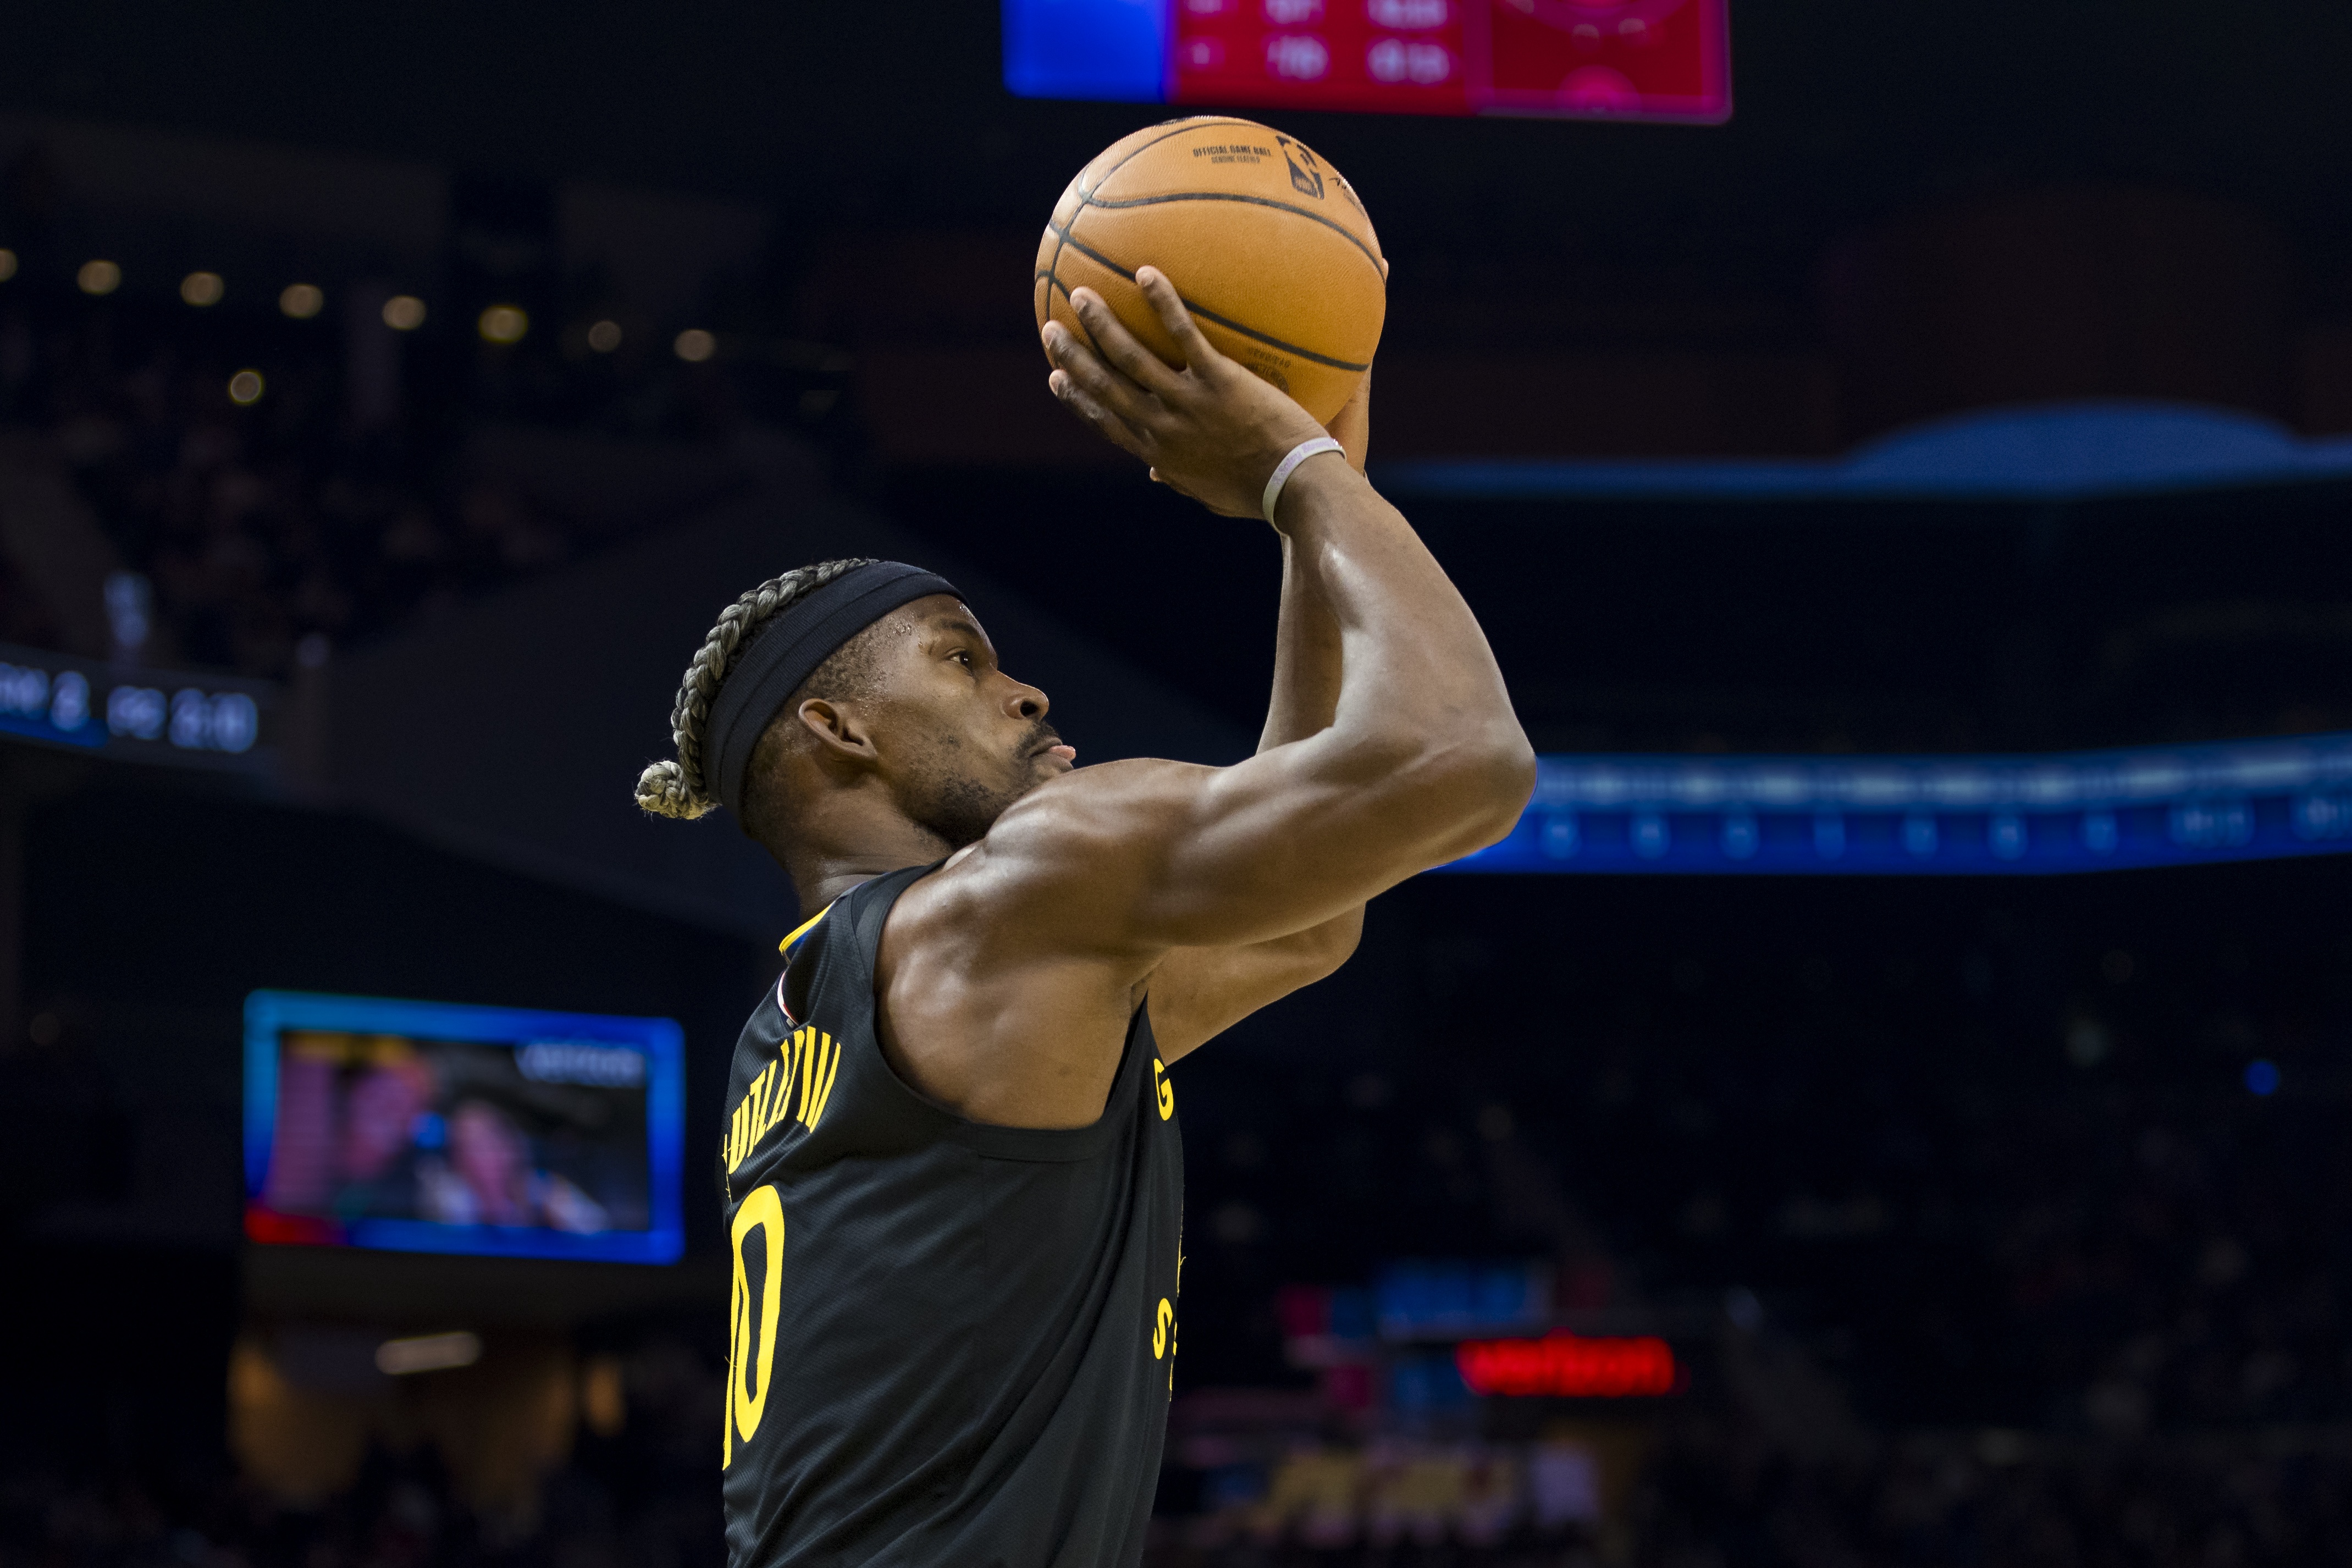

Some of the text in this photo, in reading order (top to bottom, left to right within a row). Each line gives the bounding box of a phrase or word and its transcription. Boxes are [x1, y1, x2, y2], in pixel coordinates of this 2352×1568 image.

[1193, 144, 1271, 157] OFFICIAL GAME BALL
